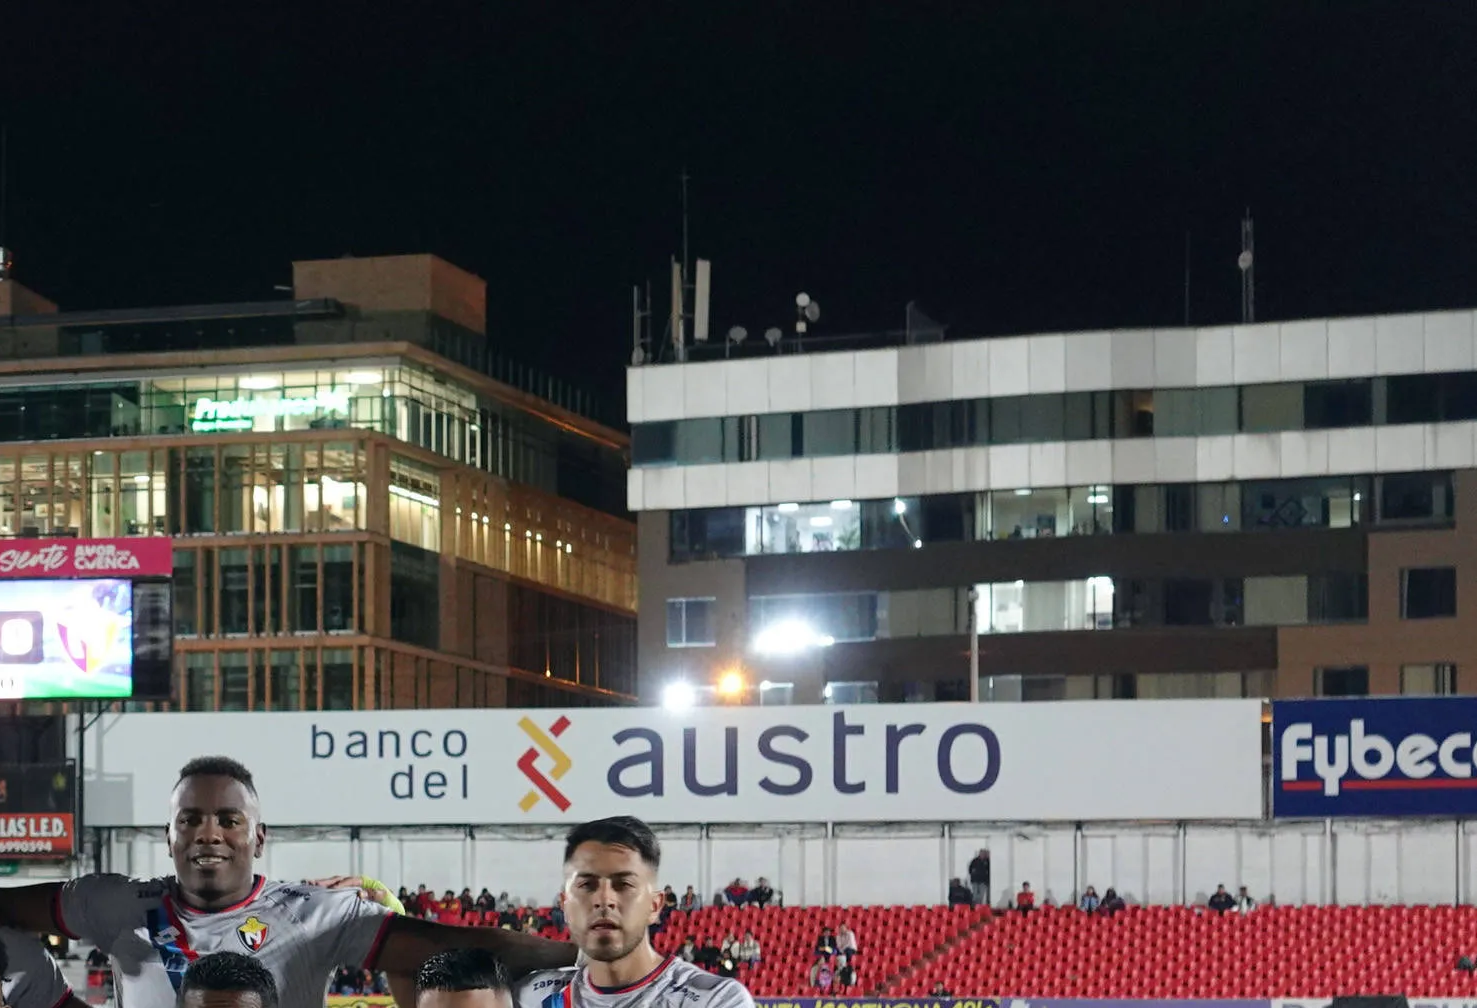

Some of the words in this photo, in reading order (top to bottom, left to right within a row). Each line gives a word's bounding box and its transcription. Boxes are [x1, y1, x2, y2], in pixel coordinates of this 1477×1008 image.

[310, 724, 468, 759] banco
[606, 711, 1002, 798] austro
[1281, 719, 1477, 796] Fybec
[389, 764, 468, 799] del
